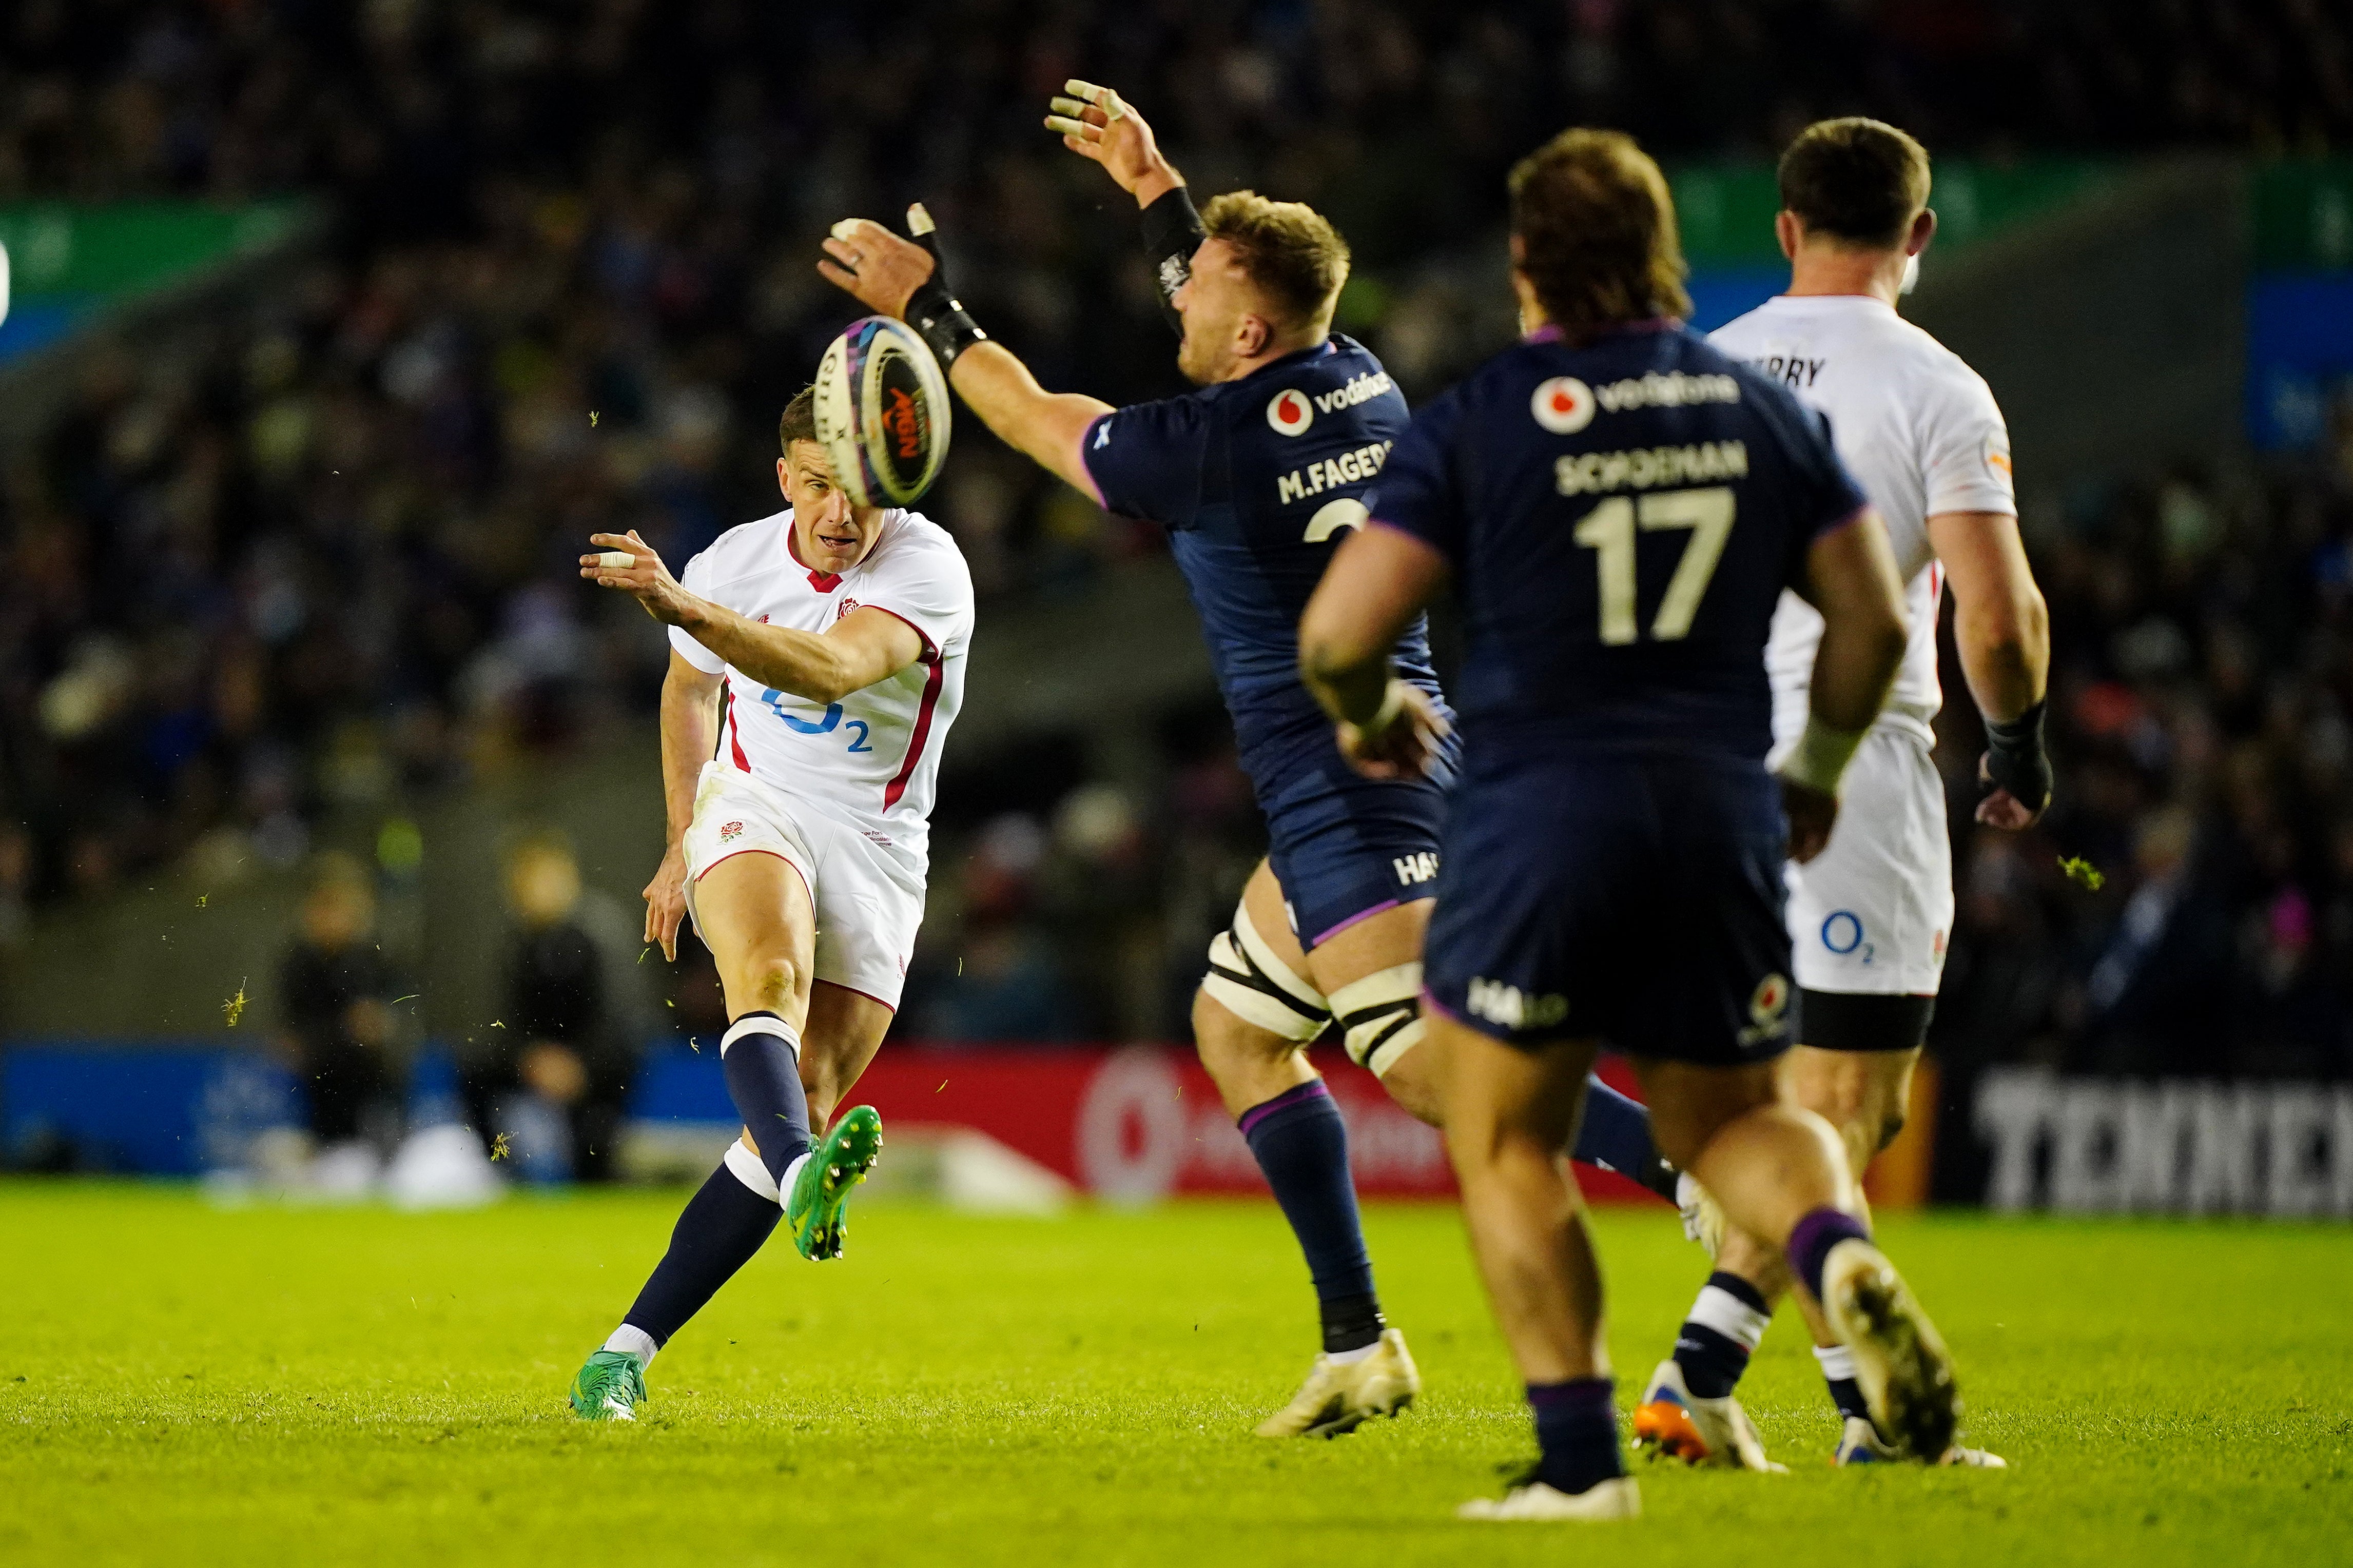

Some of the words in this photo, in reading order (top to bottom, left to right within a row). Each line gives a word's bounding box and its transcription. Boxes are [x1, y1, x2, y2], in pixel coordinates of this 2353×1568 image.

[1755, 356, 1825, 386] RRY
[1555, 440, 1747, 496] SCHOEMAN
[1573, 486, 1736, 645] 17
